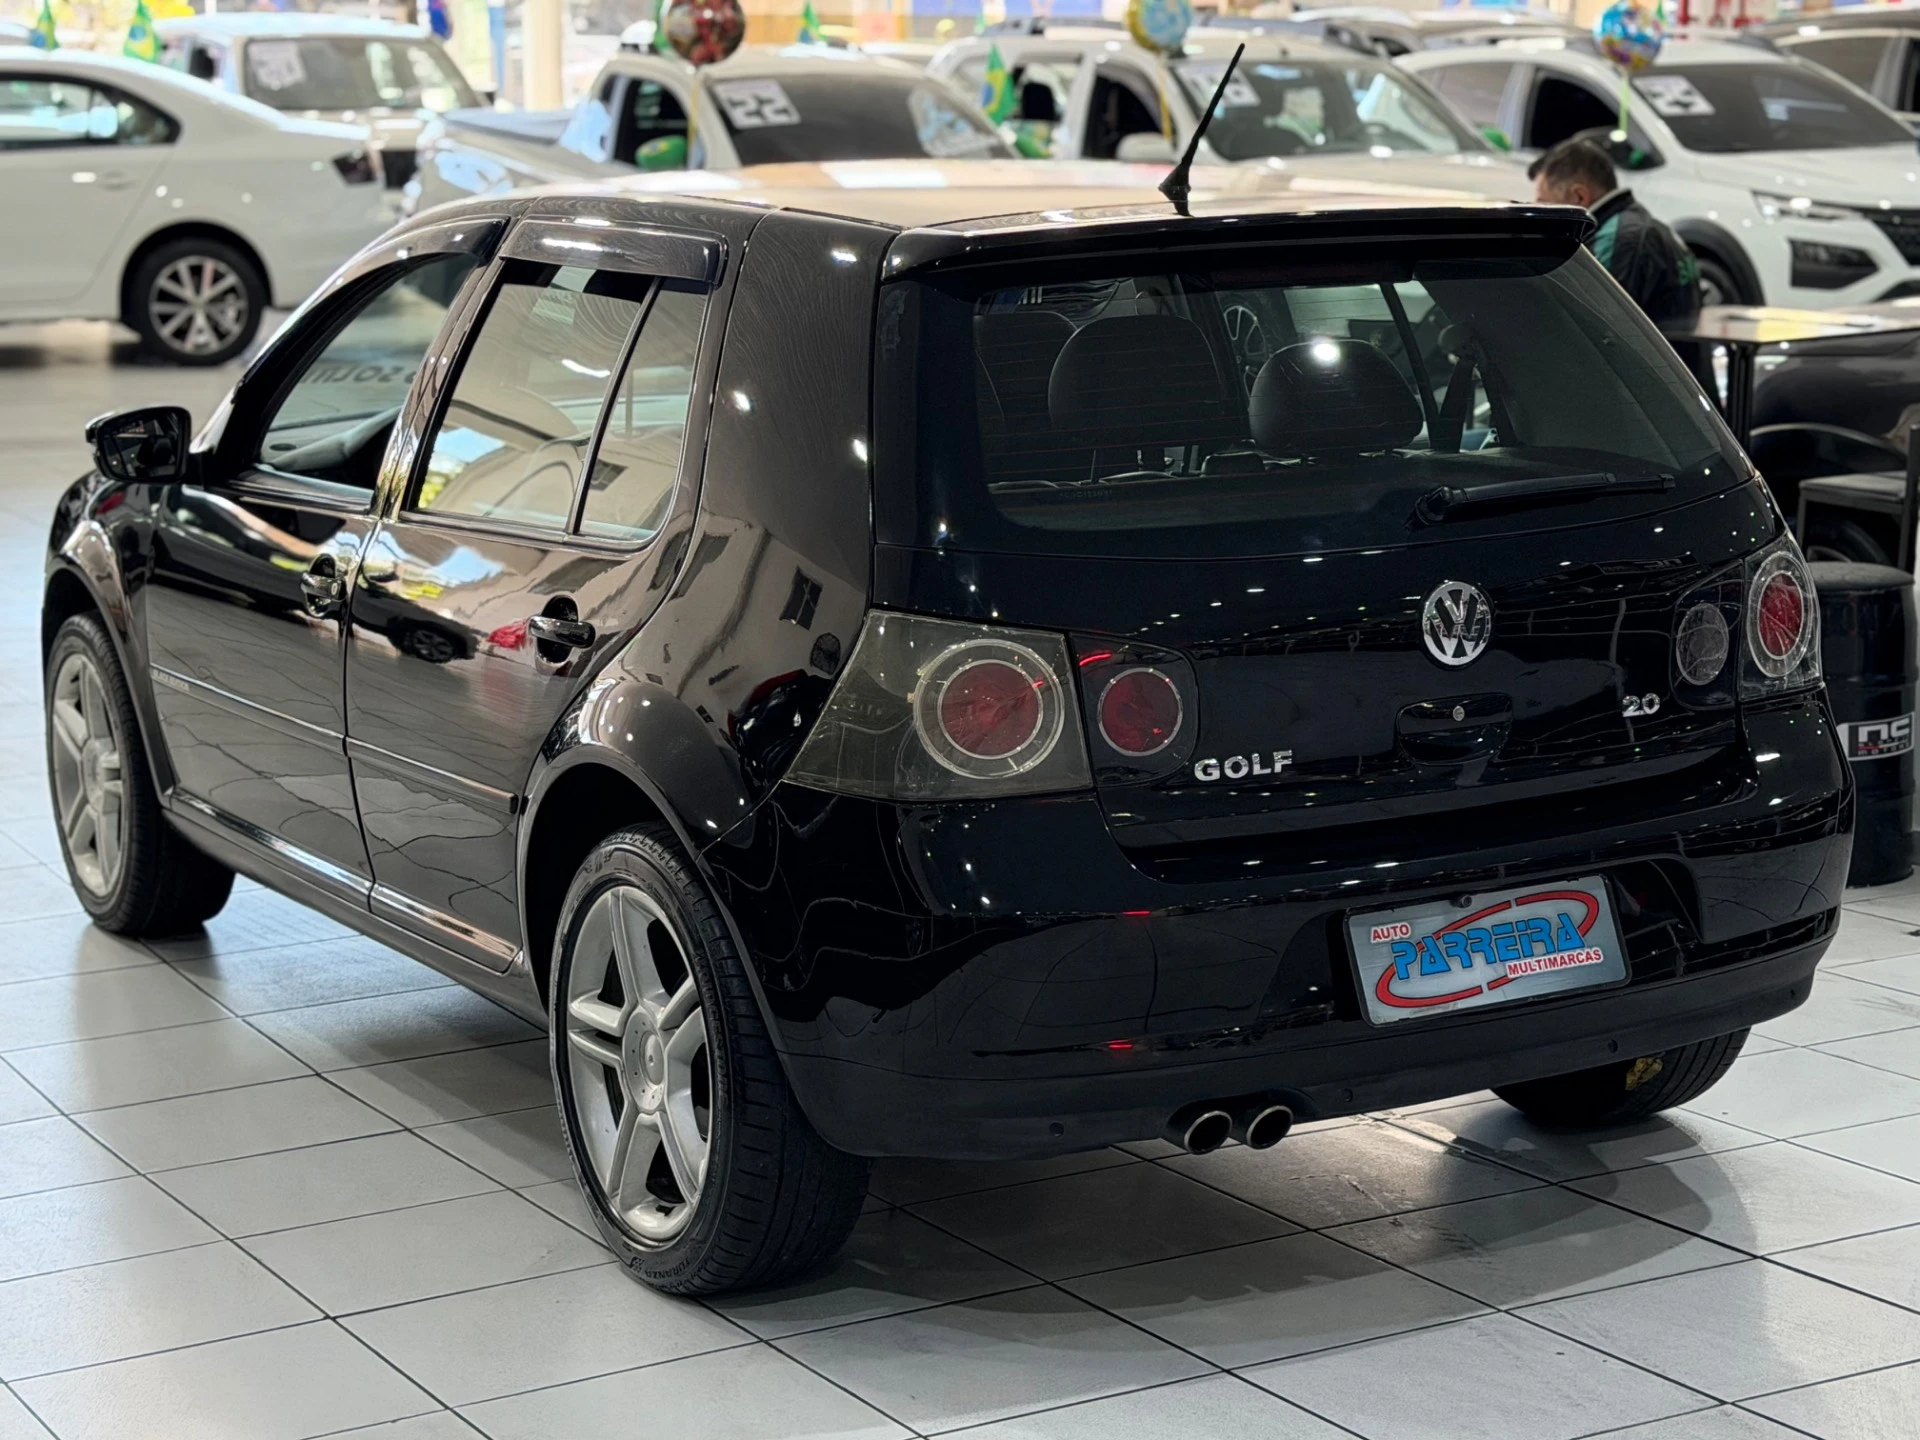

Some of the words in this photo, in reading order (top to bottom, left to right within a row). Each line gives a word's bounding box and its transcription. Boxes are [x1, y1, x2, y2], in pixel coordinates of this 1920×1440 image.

[1194, 749, 1292, 781] GOLF
[1371, 923, 1410, 942] AUTO
[1391, 912, 1585, 980] PARREIRA
[1507, 949, 1602, 977] MULTIMARCAS
